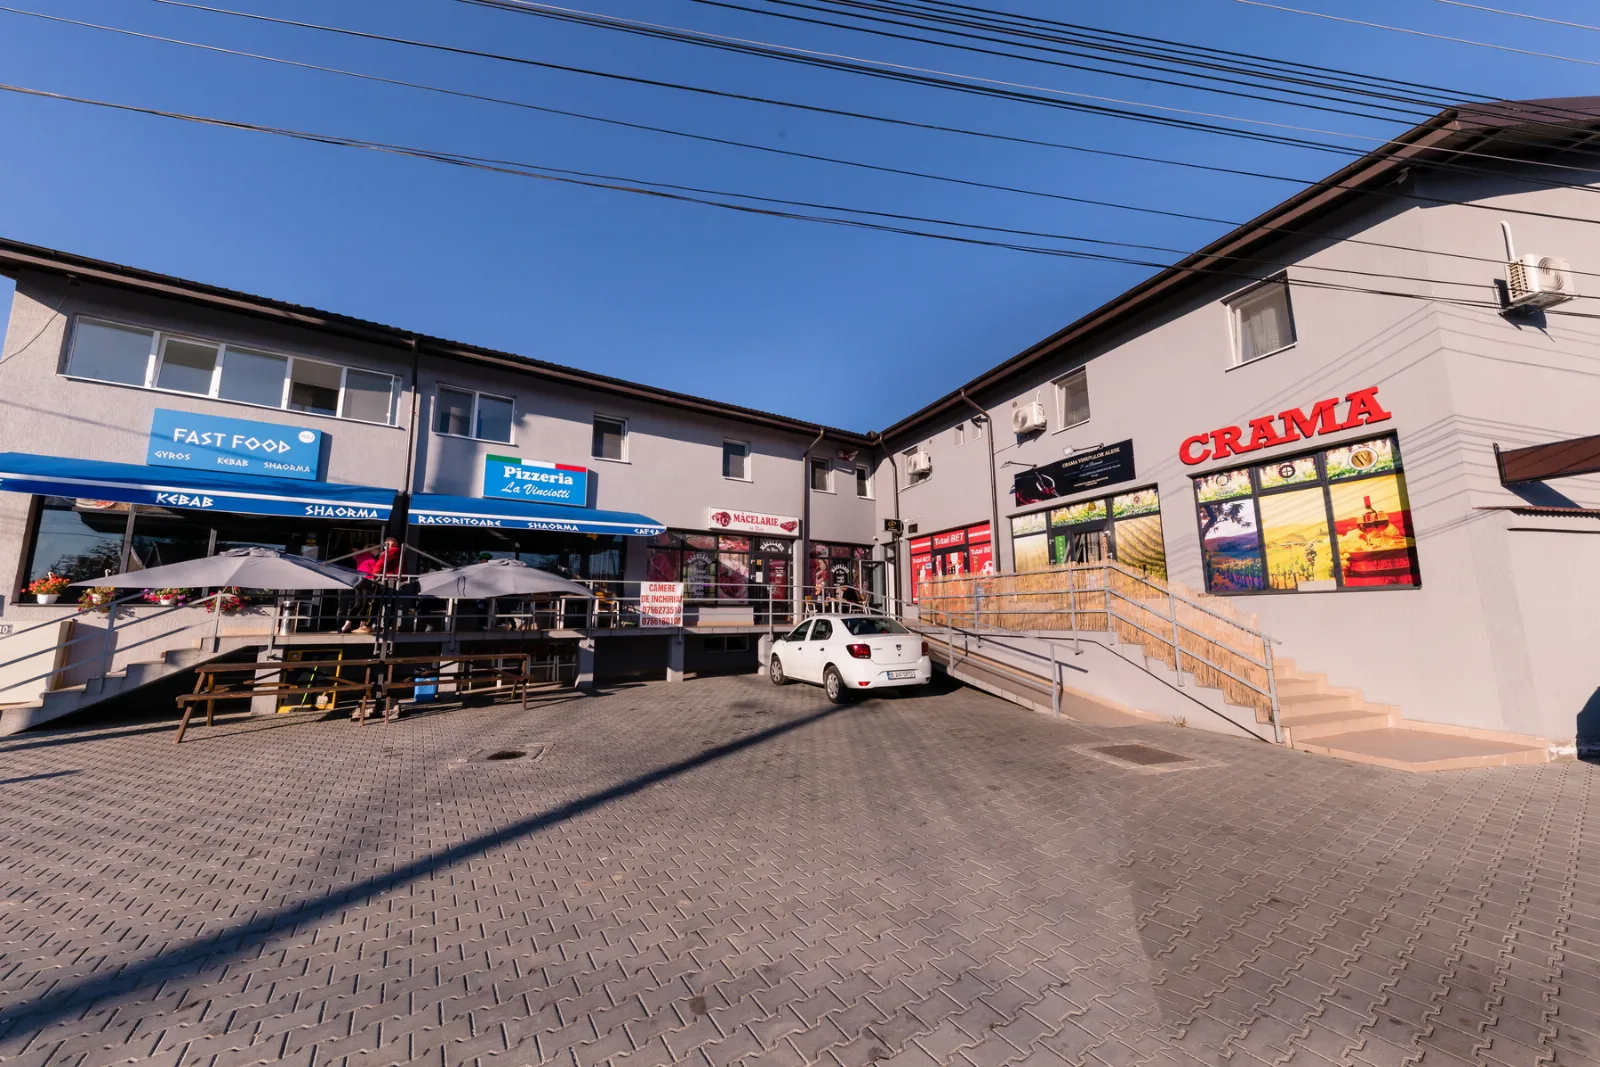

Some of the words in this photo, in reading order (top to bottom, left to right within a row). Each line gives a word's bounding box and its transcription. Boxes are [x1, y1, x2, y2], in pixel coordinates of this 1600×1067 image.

[1179, 386, 1392, 465] CRAMA
[173, 428, 226, 447] FAST
[232, 434, 291, 454] FOOD
[154, 450, 191, 461] GYROS
[217, 457, 249, 467] KEBAB
[263, 461, 310, 473] SHAORMA
[1062, 460, 1078, 468] CRAMA
[503, 465, 573, 486] Pizzeria
[501, 482, 521, 494] La
[523, 485, 570, 499] Vinciotti
[156, 492, 214, 508] KEBAB
[305, 504, 378, 518] SHAORMA
[418, 515, 501, 527] RACORITOARE
[528, 522, 579, 531] SHAORMA
[634, 527, 660, 536] CAFEA
[935, 537, 950, 545] Total
[950, 532, 964, 543] BET
[649, 584, 676, 592] CAMERE
[641, 595, 650, 603] DE
